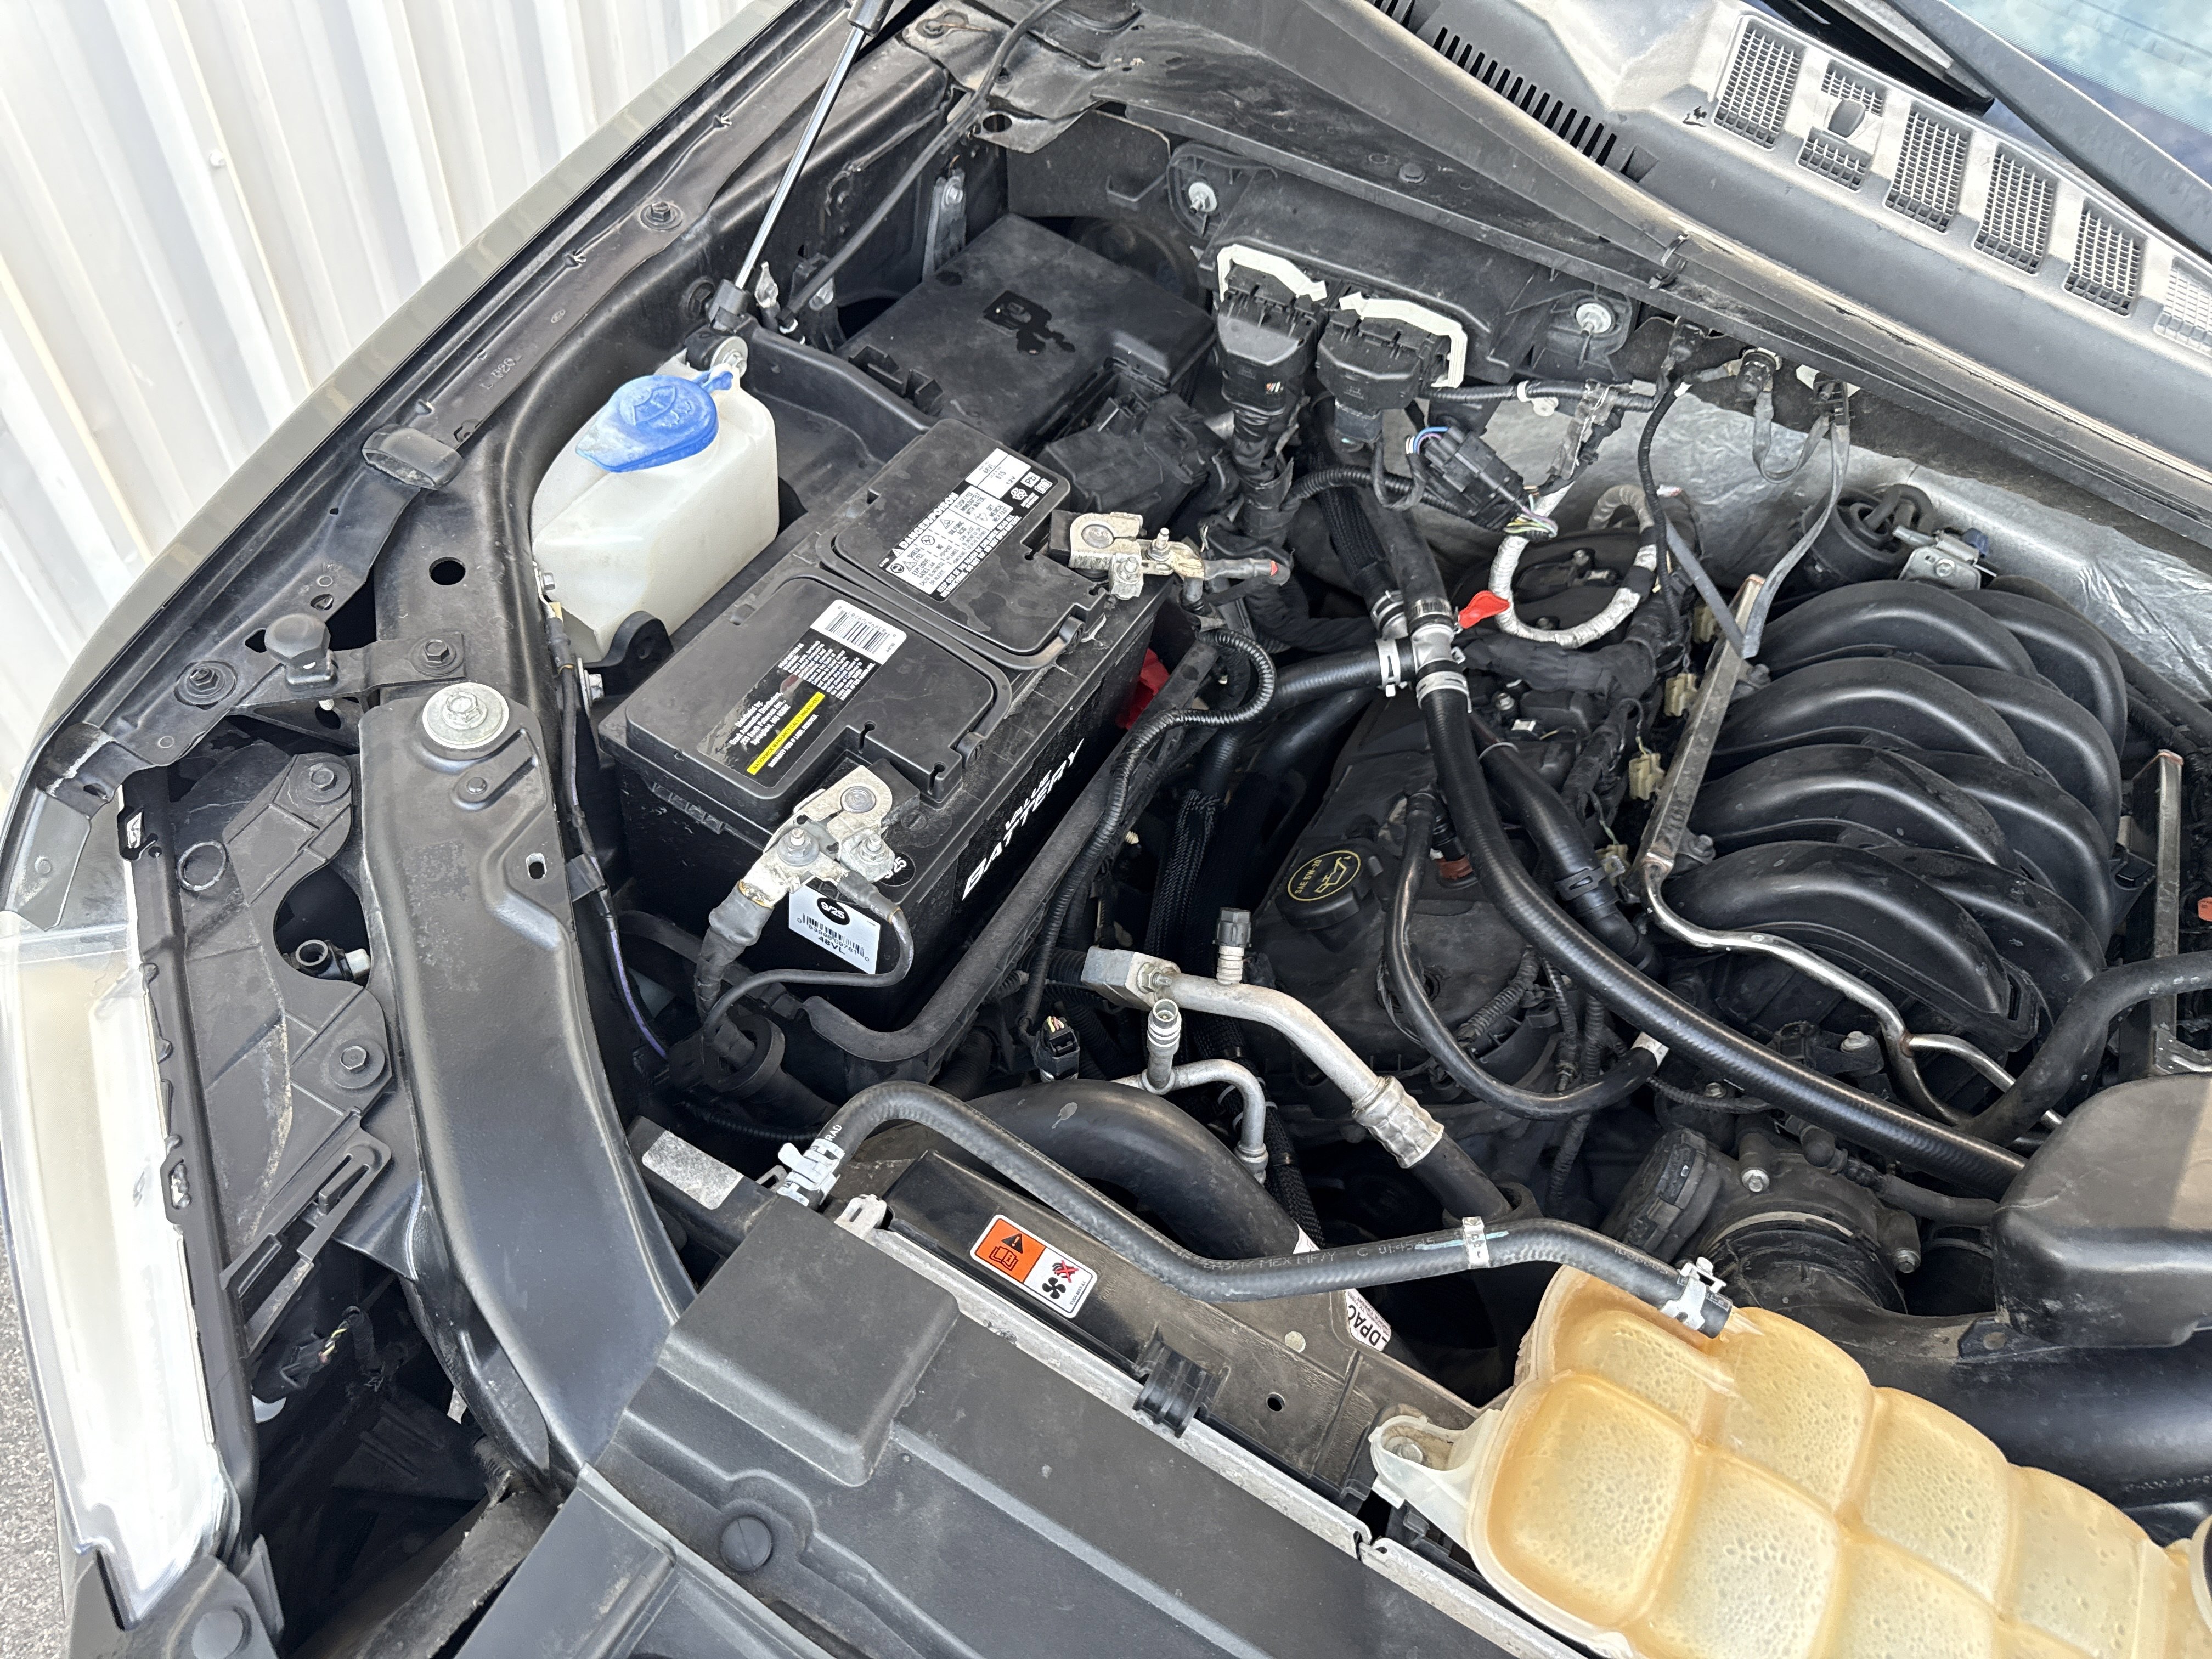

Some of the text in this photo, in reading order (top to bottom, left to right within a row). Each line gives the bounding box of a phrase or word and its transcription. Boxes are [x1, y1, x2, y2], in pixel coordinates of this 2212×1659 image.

[1005, 476, 1017, 485] 12V
[1024, 475, 1037, 484] Pb
[898, 490, 960, 550] DANGER/POISON
[734, 705, 758, 727] Distributed
[739, 735, 751, 745] 233
[746, 724, 761, 737] South
[757, 707, 777, 726] Patterson
[770, 715, 781, 724] MO
[728, 732, 743, 746] Ozark
[738, 712, 763, 735] Automotive
[751, 746, 775, 769] NATIONWIDE
[771, 727, 792, 748] WARRANTY
[789, 719, 800, 729] CALL
[766, 748, 787, 768] WARRANTY
[792, 727, 806, 740] LABEL
[962, 738, 1084, 901] BATTERY
[1295, 881, 1307, 894] SAE
[821, 901, 845, 919] 9/25
[818, 936, 845, 955] 48VL
[825, 1125, 842, 1141] RAD
[1348, 1305, 1387, 1346] DPAC
